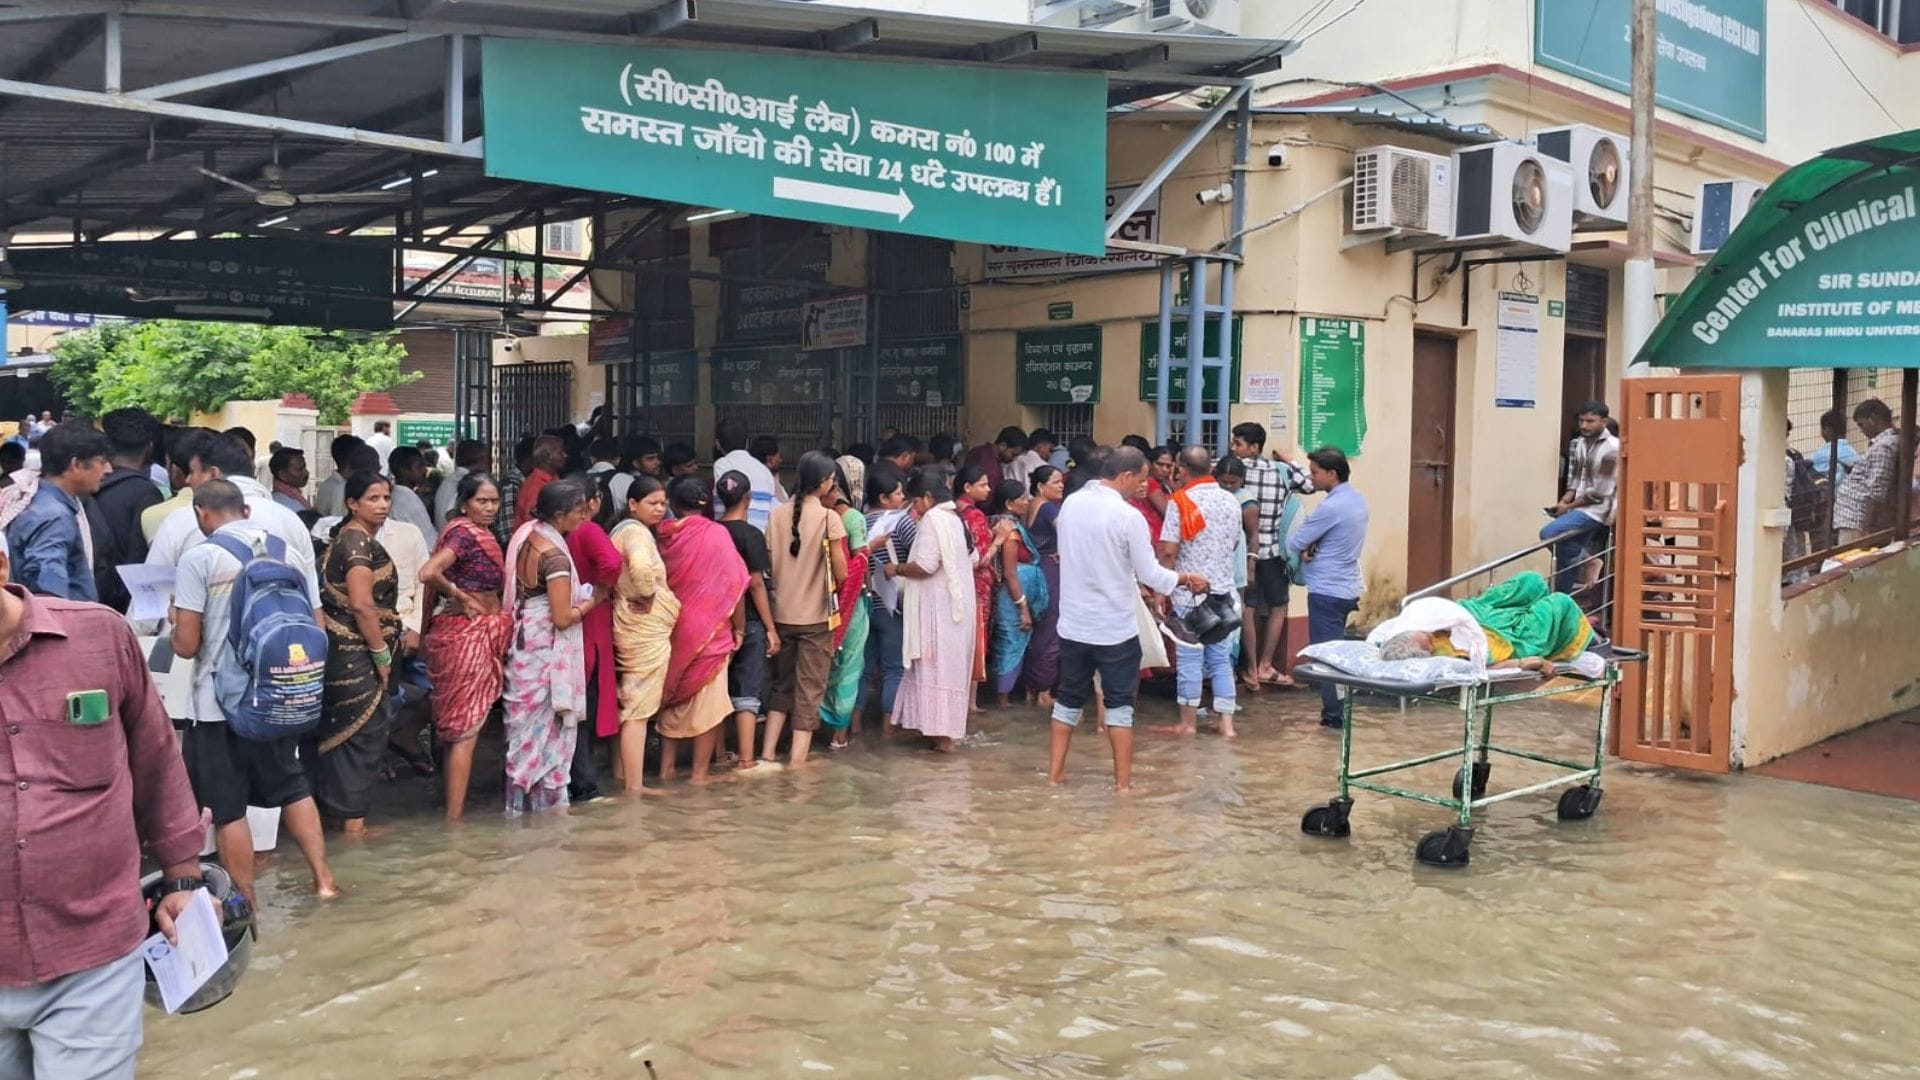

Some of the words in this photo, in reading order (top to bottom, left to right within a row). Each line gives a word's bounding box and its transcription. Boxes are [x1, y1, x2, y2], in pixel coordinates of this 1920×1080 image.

[580, 106, 685, 146] समस्त
[773, 134, 814, 167] की
[819, 142, 872, 177] सेवा
[877, 158, 903, 182] 24
[950, 169, 1031, 201] उपलब्ध
[804, 100, 861, 146] लैब)
[870, 119, 940, 151] कमरा
[984, 141, 1015, 165] 100
[1020, 141, 1045, 169] में
[1692, 265, 1768, 345] Center
[1758, 235, 1806, 279] For
[1804, 187, 1916, 251] Clinical
[1818, 274, 1852, 290] SIR
[1778, 302, 1863, 317] INSTITUTE
[1867, 301, 1893, 316] OF
[1767, 327, 1821, 337] BANARAS
[1825, 327, 1863, 337] HINDU
